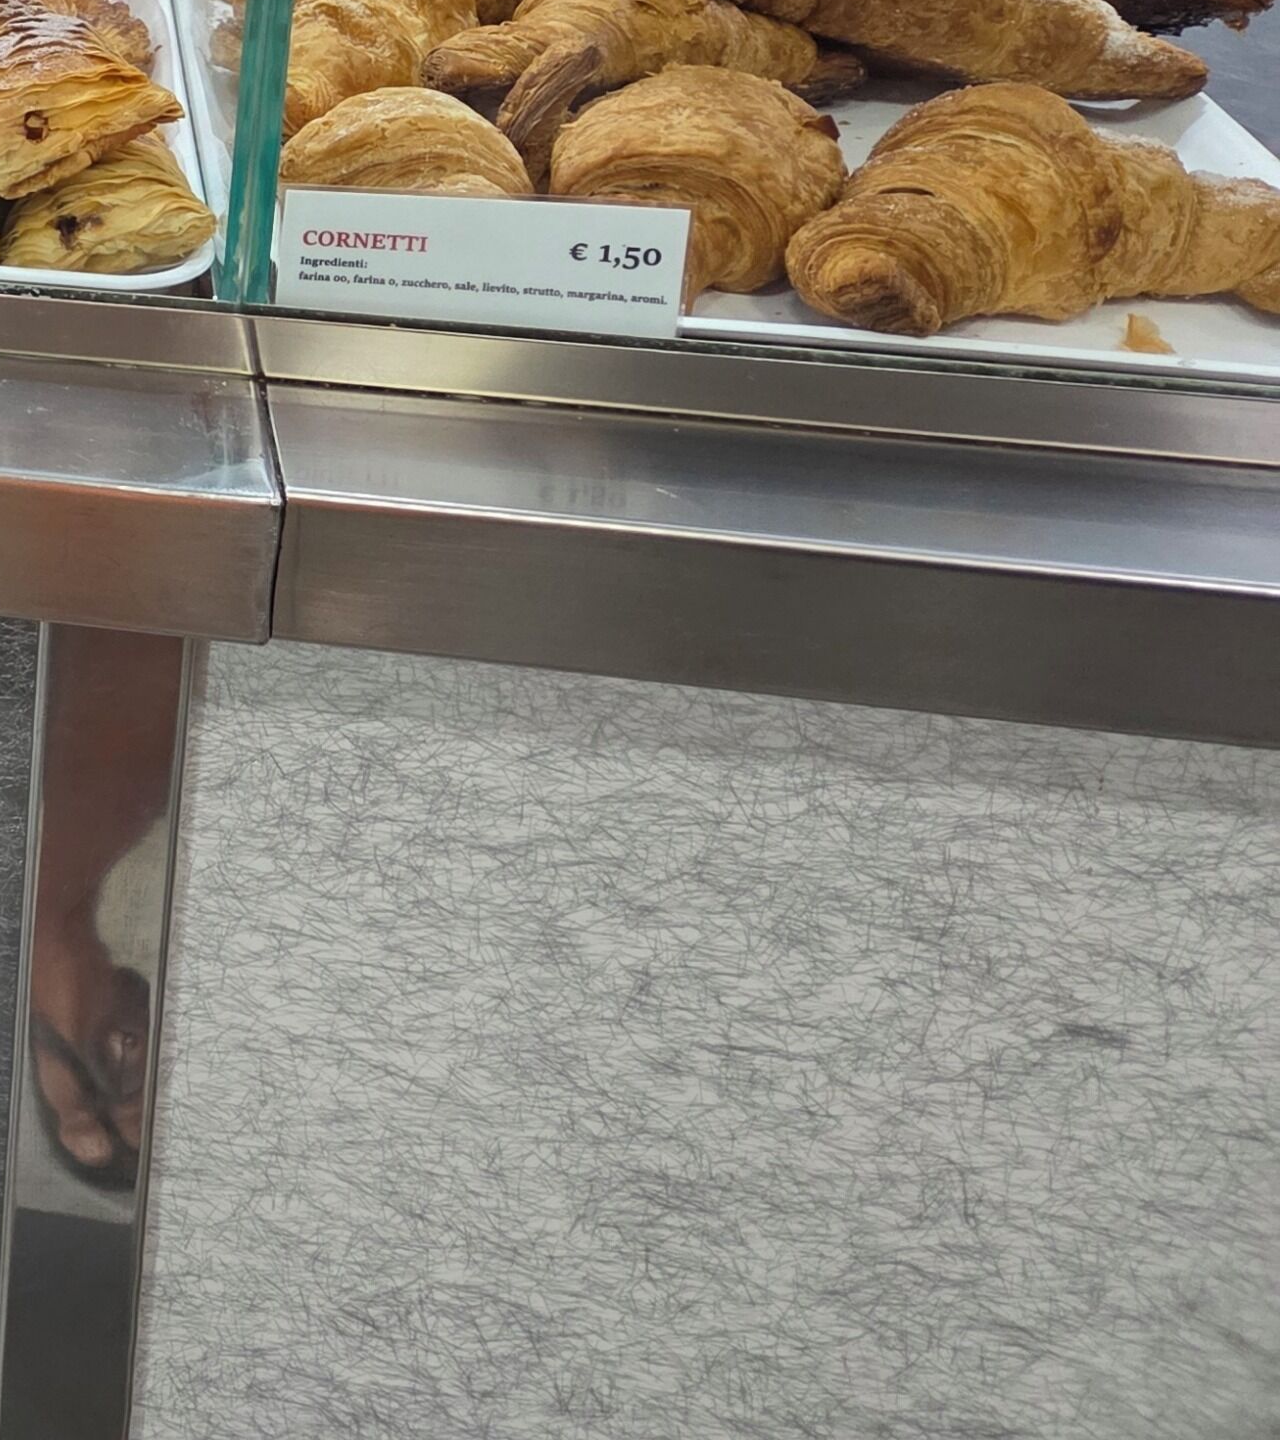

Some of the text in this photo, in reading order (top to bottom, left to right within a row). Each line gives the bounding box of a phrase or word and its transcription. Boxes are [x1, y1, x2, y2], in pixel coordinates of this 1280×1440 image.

[302, 229, 429, 253] CORNETTI
[299, 256, 368, 269] Ingredienti:
[568, 242, 663, 271] € 1,50
[298, 270, 331, 283] farina
[353, 273, 386, 286] farina
[401, 276, 452, 291] zucchero,
[455, 279, 480, 293] sale,
[482, 282, 520, 296] lievito,
[522, 285, 564, 299] strutto,
[567, 289, 628, 304] margarina,
[630, 294, 668, 307] aromi.
